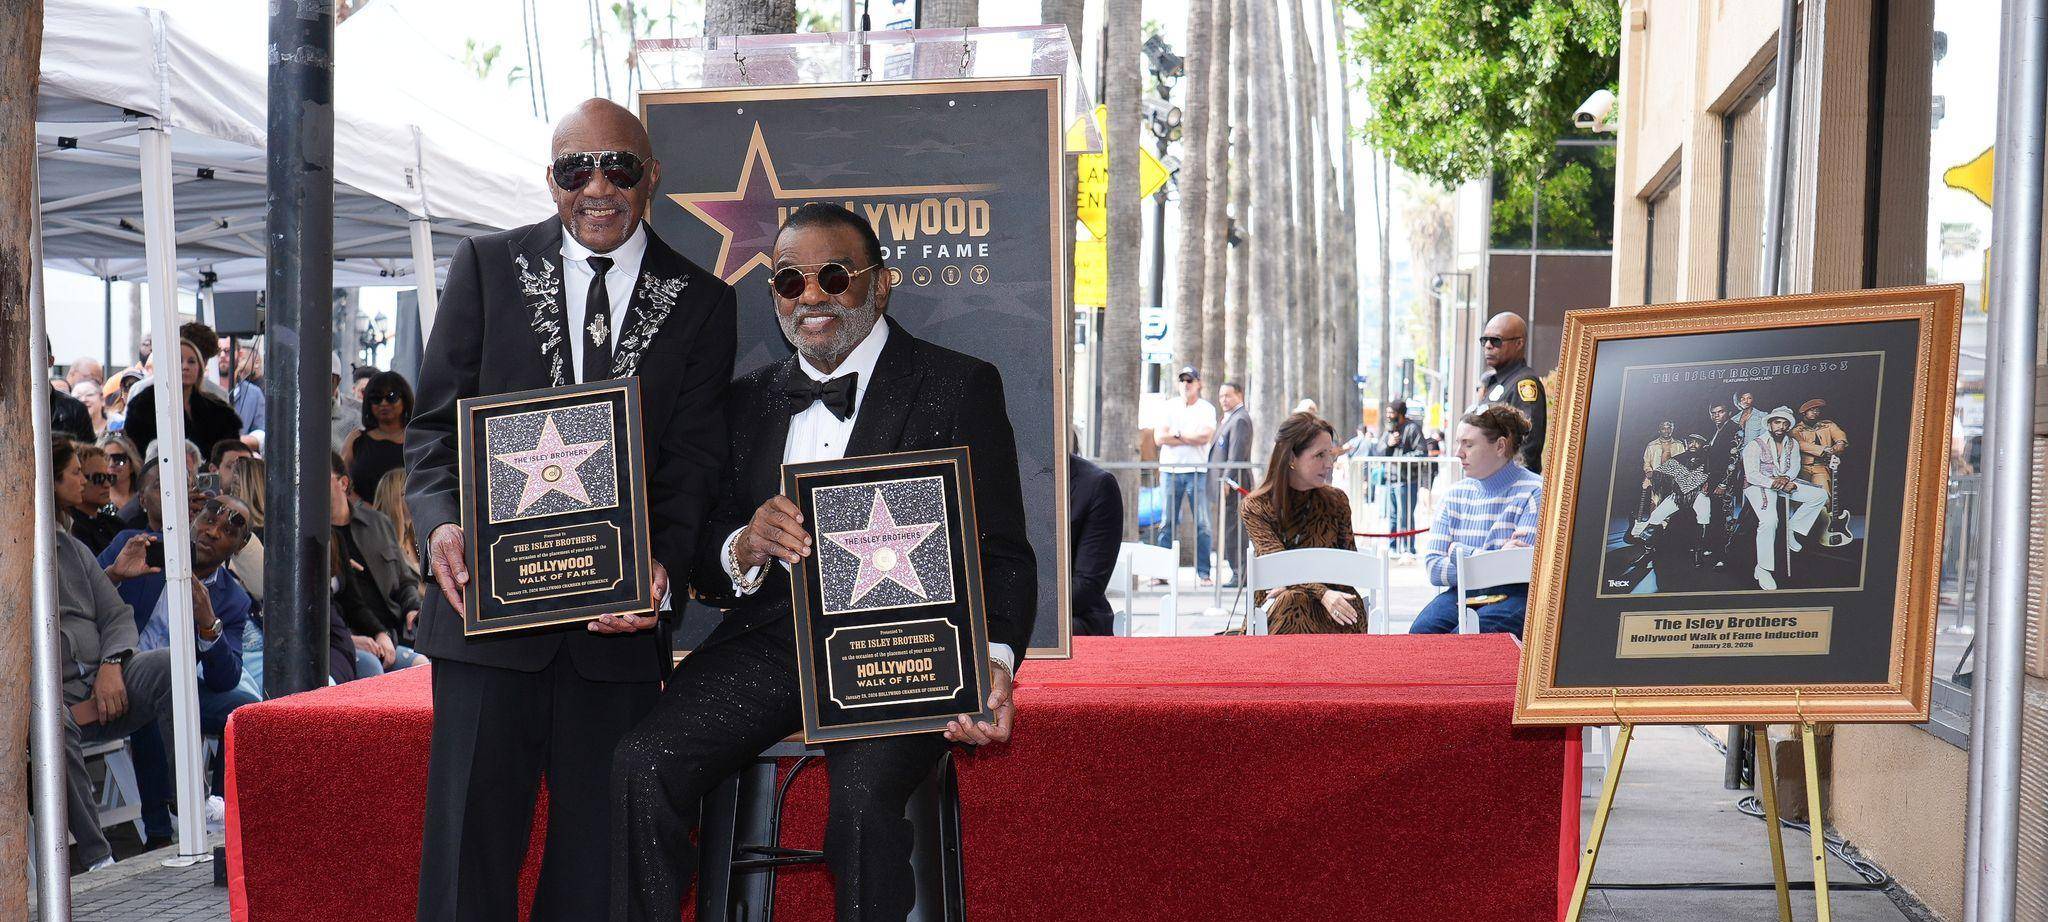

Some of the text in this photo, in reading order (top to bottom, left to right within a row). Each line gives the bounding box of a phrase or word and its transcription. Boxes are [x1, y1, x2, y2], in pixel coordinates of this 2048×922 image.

[778, 198, 990, 241] YWOOD
[880, 244, 988, 260] OF FAME
[1653, 372, 1679, 384] THE
[1685, 370, 1726, 380] ISLEY
[1730, 364, 1810, 378] BROTHERS
[530, 454, 548, 462] ISLEY
[550, 448, 588, 460] BROTHERS
[514, 534, 597, 552] THE ISLEY BROTHERS
[860, 536, 880, 544] ISLEY
[882, 532, 920, 542] BROTHERS
[520, 555, 594, 576] HOLLYWOOD
[518, 575, 547, 584] WALK
[566, 568, 596, 578] FAME
[1654, 616, 1798, 630] The Isley Brothers
[850, 634, 935, 649] THE ISLEY BROTHERS
[1630, 630, 1819, 643] Hollywood Walk of Fame Induction
[857, 658, 932, 678] HOLLYWOOD
[856, 678, 886, 687] WALK
[906, 673, 936, 683] FAME
